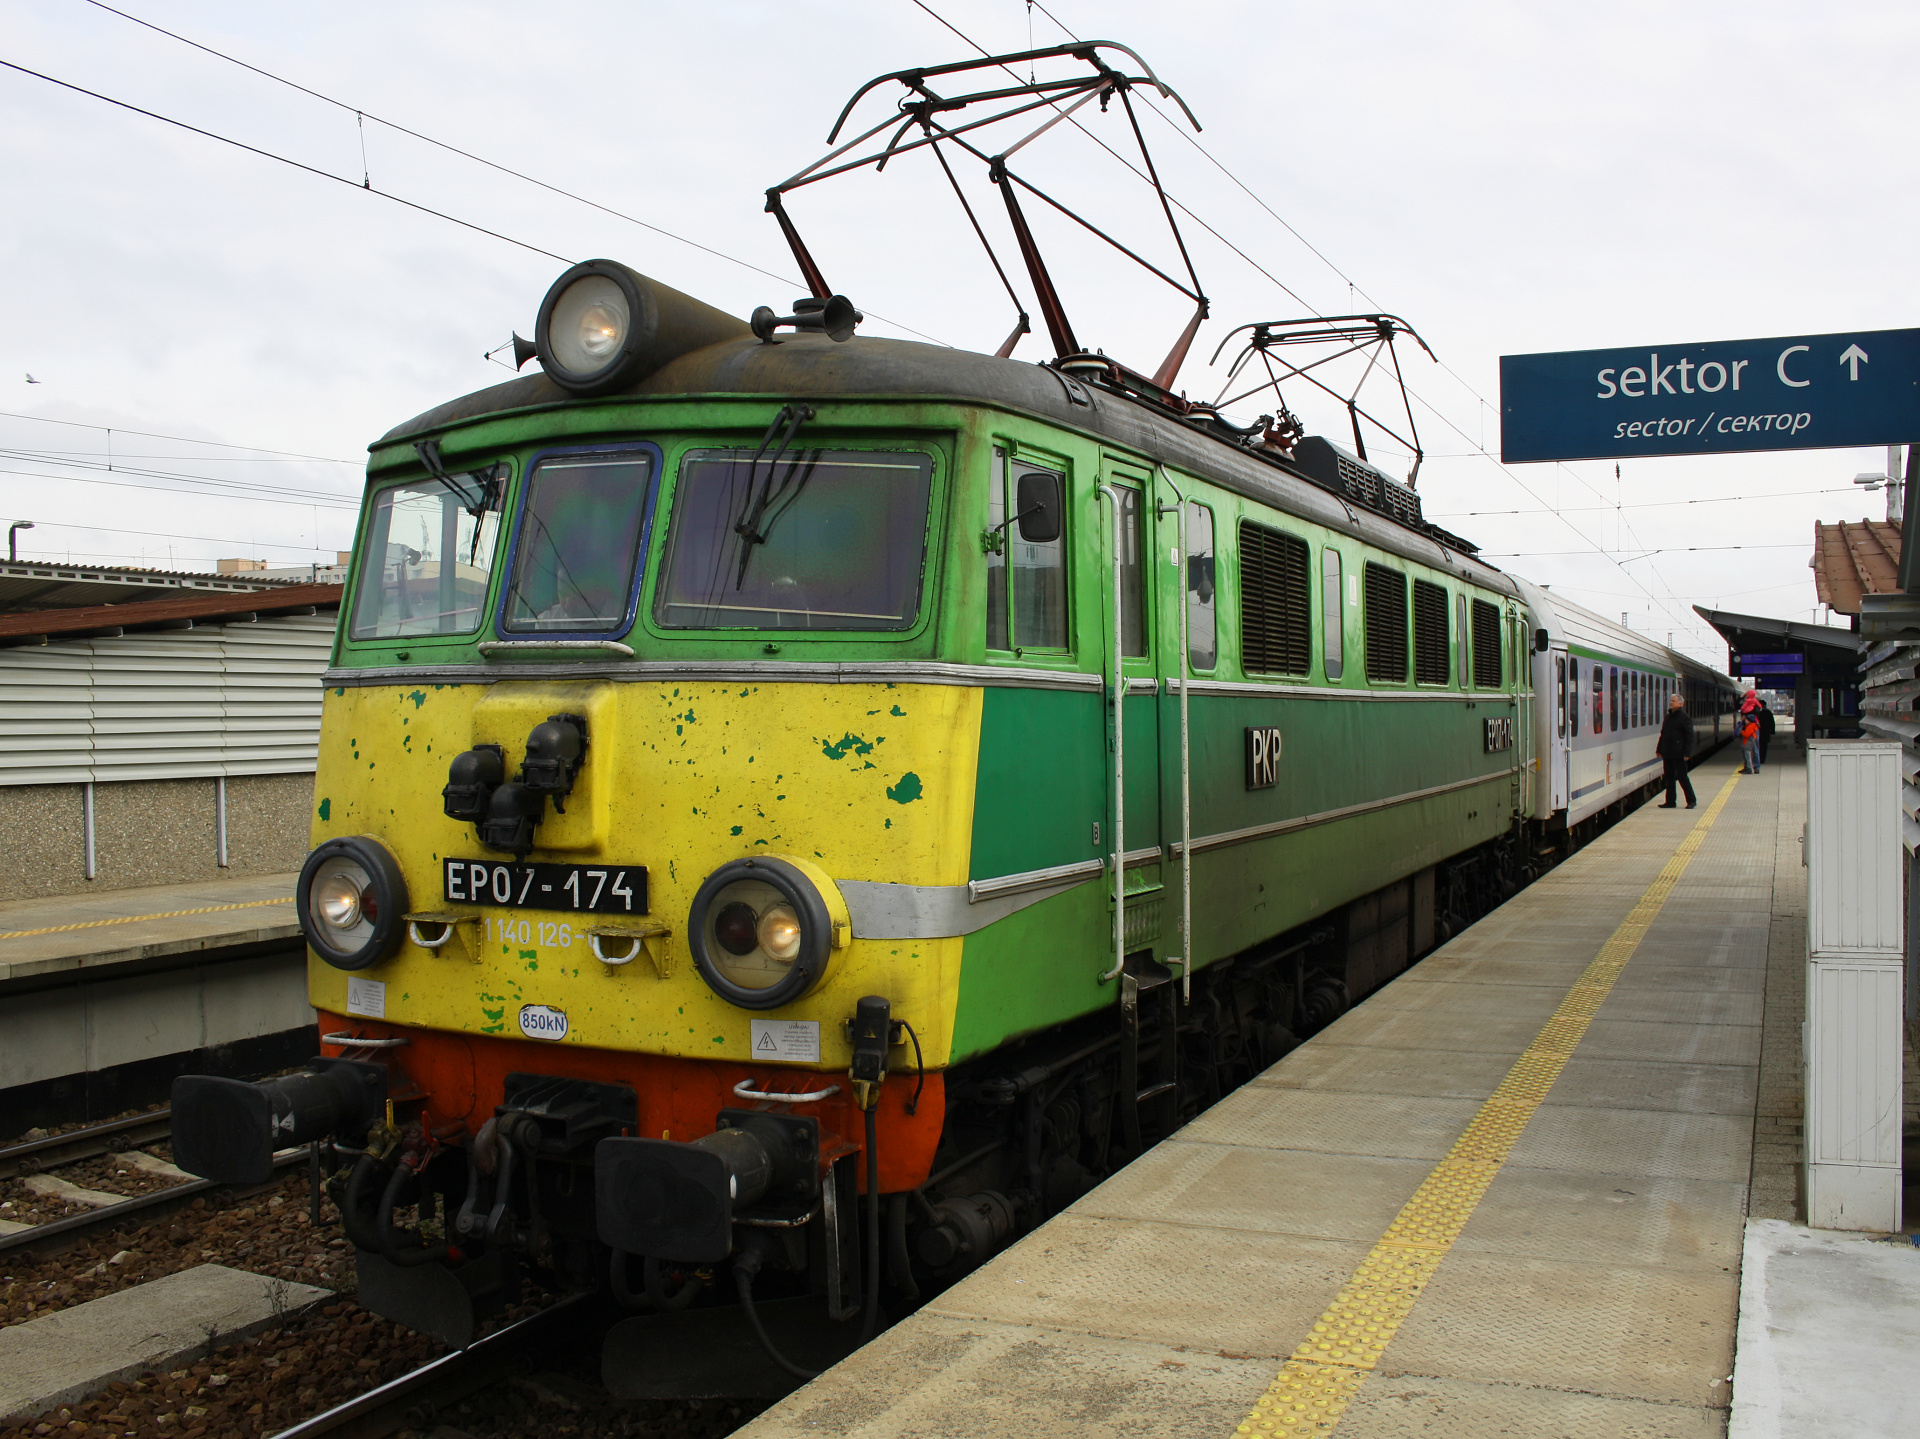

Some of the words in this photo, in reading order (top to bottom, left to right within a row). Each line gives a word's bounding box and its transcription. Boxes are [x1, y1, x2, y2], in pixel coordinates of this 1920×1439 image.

[1597, 353, 1748, 399] sektor
[1776, 345, 1810, 387] C
[1613, 414, 1696, 439] sector
[1716, 411, 1812, 435] сектор
[1253, 728, 1282, 784] PKP
[447, 862, 633, 911] EP07-174
[497, 918, 531, 945] 140
[522, 1012, 565, 1033] 850kN
